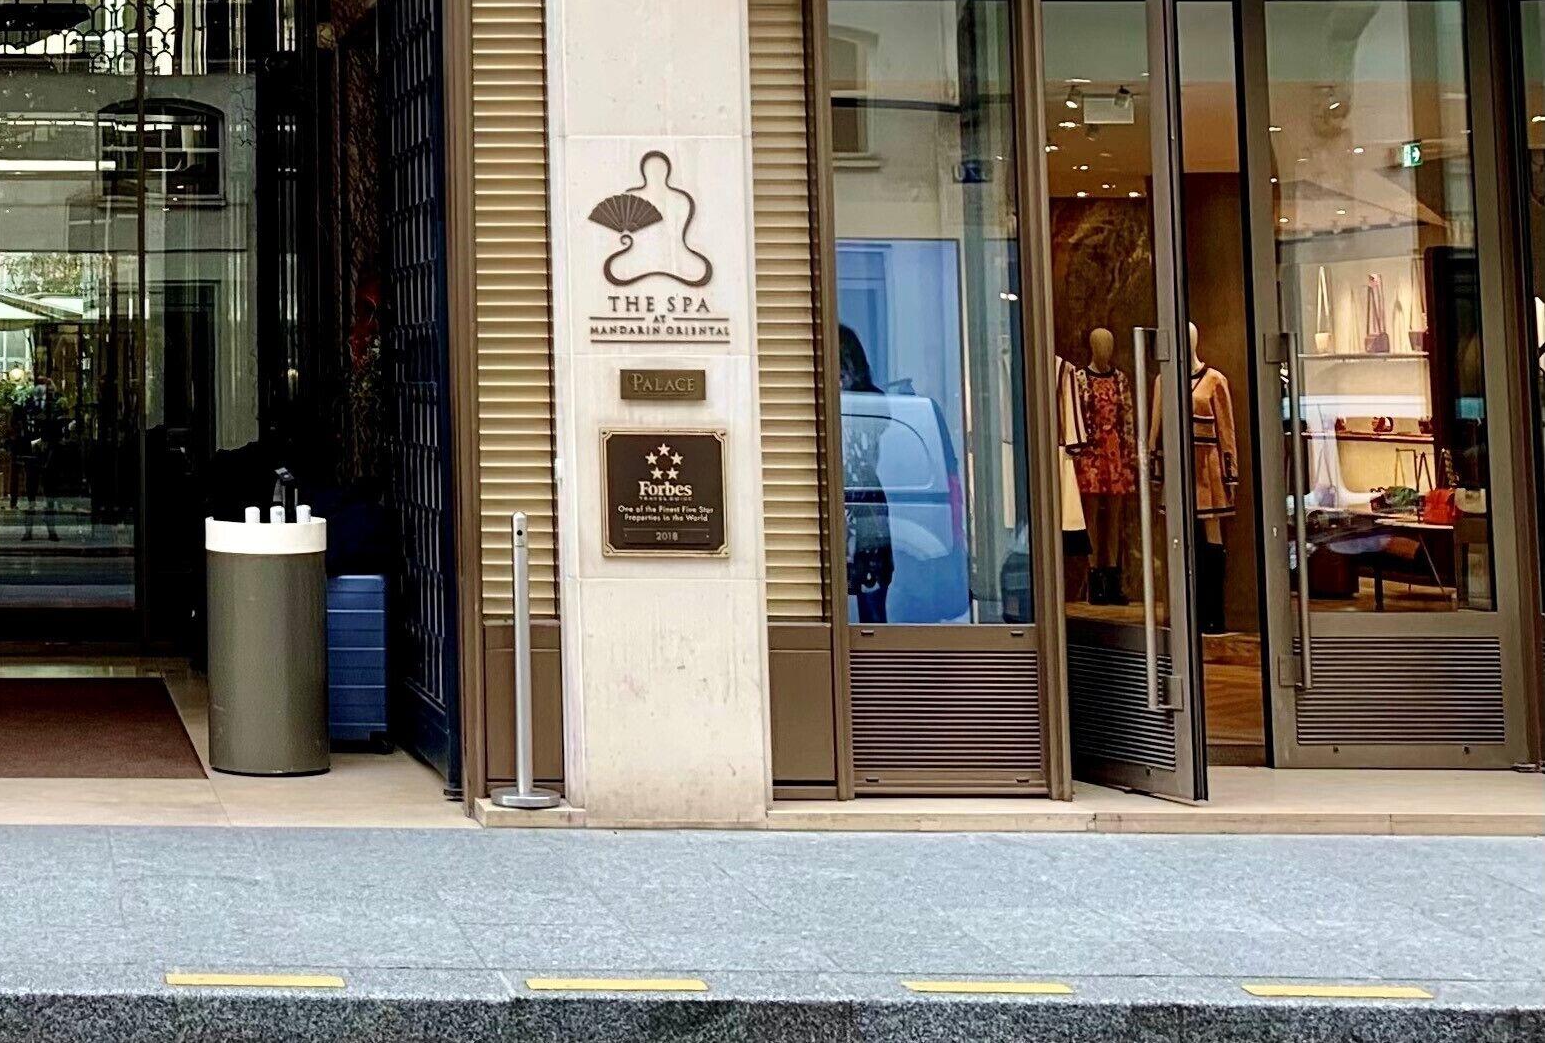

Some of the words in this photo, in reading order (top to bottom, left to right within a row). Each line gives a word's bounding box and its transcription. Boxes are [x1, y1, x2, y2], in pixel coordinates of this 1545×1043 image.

[607, 295, 655, 313] THE
[667, 295, 710, 313] SPA
[653, 314, 666, 324] AT
[590, 325, 660, 335] MANDARIN
[666, 325, 730, 336] ORIENTAL
[638, 481, 693, 496] Forbes
[617, 505, 634, 513] One
[635, 505, 644, 513] of
[645, 505, 657, 513] the
[624, 513, 661, 522] Properties
[672, 513, 684, 521] the
[685, 514, 709, 522] World
